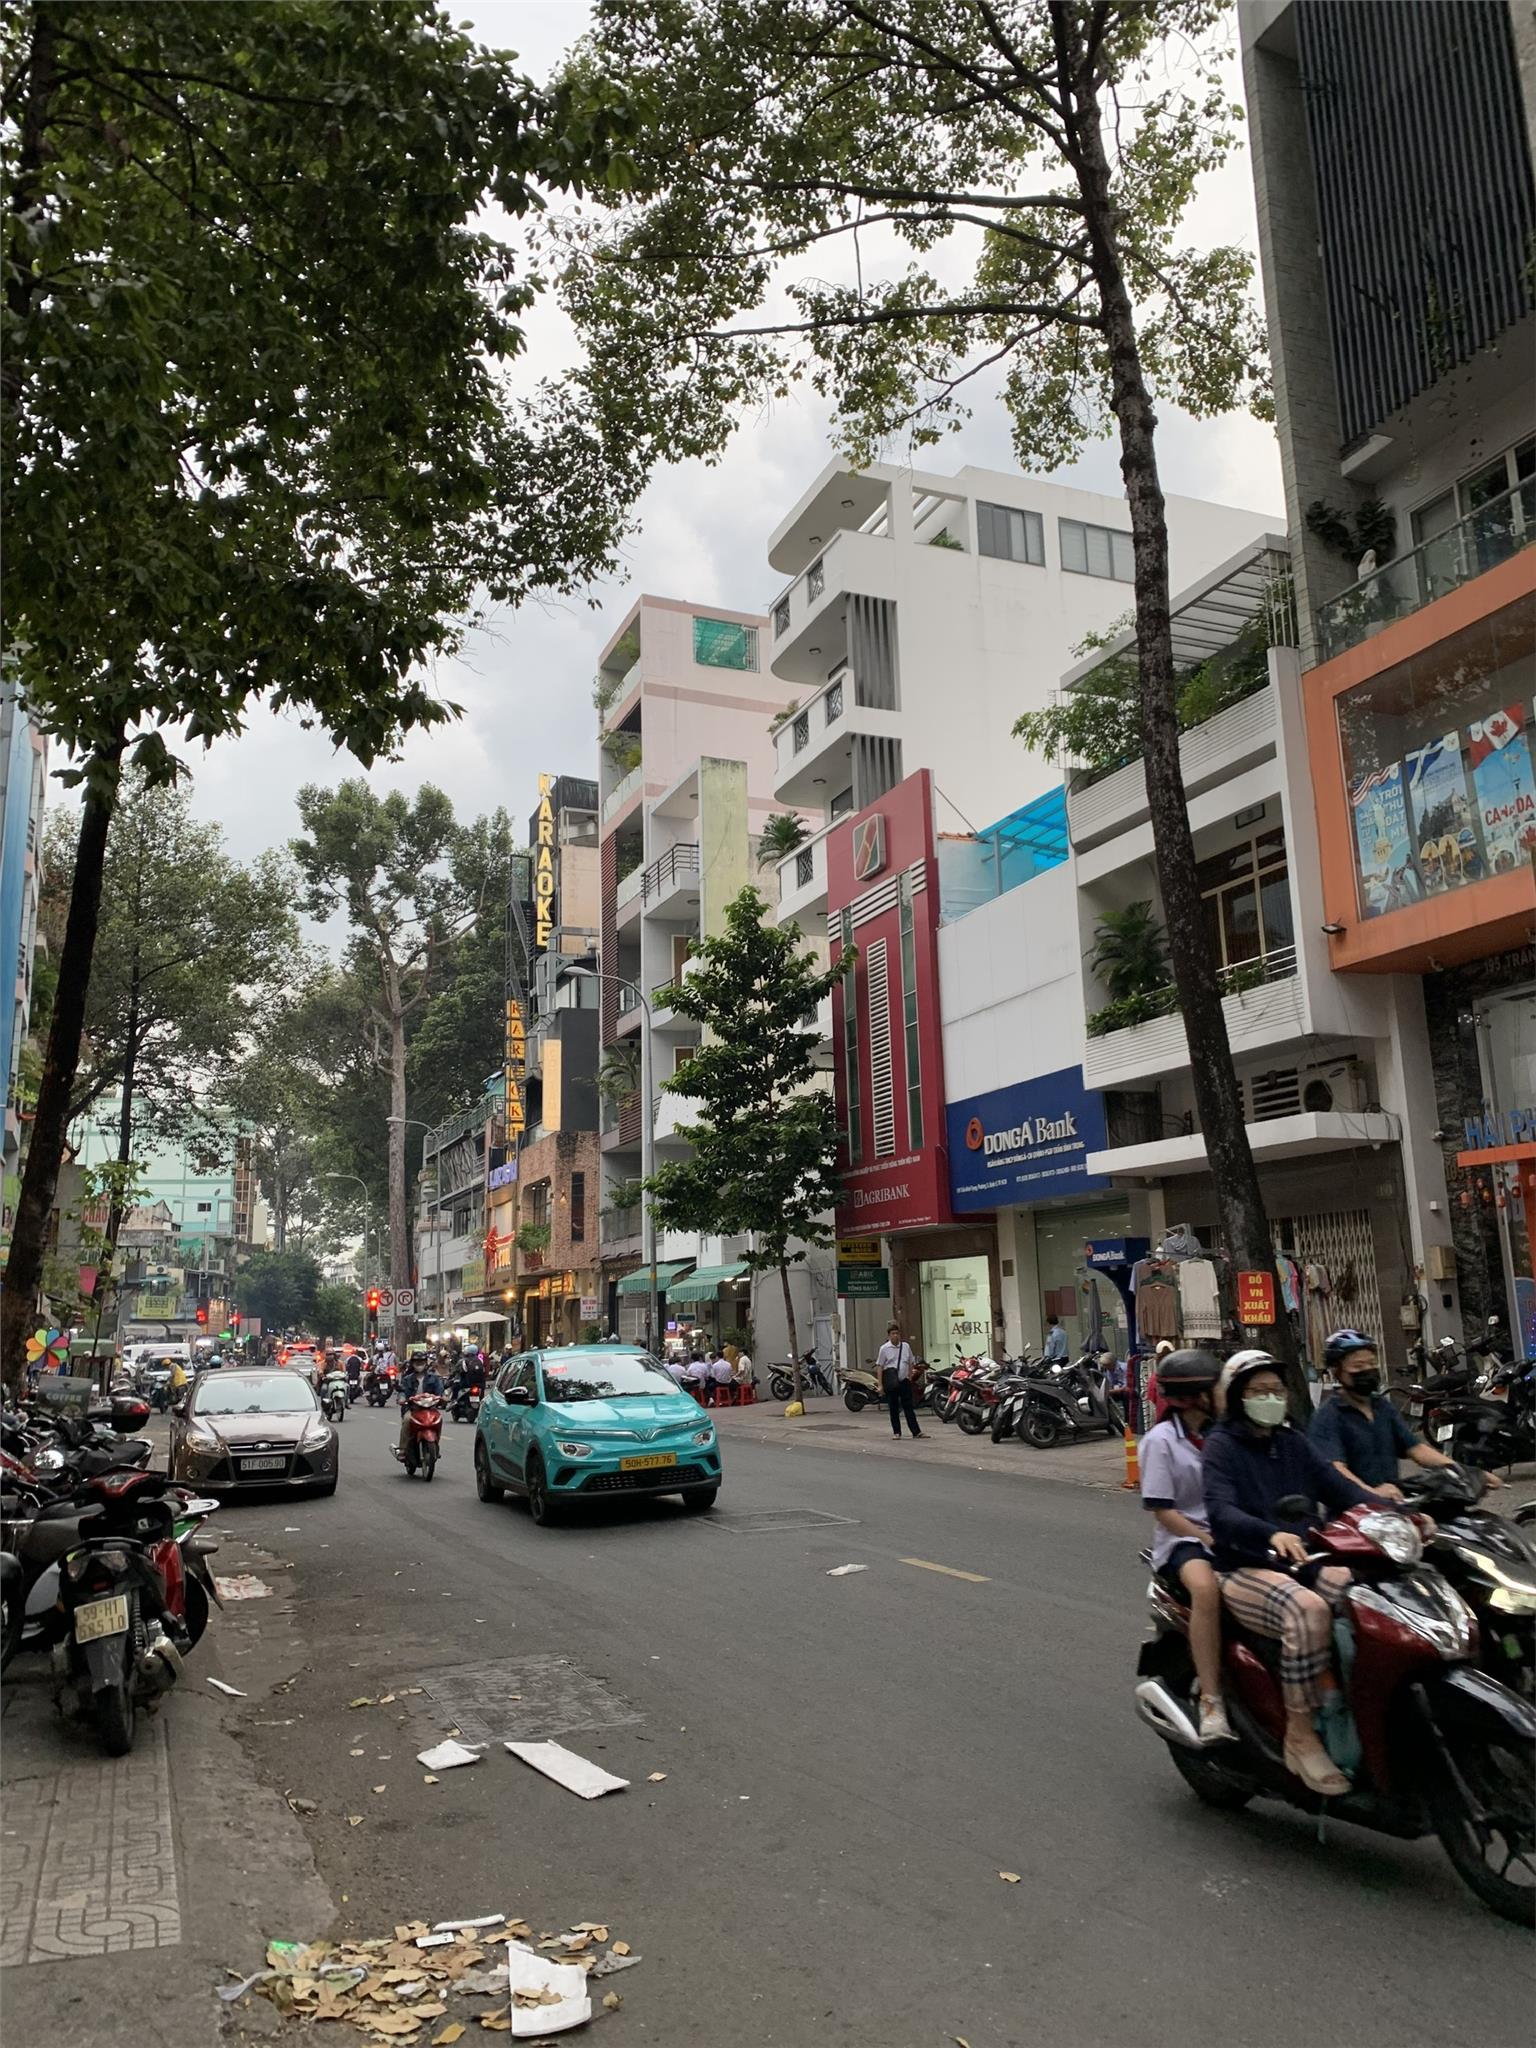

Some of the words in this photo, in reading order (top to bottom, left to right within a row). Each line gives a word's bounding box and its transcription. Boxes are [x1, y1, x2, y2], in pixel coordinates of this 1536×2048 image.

[1485, 794, 1535, 826] CANADA
[537, 772, 553, 947] KARAOKE
[1035, 1110, 1079, 1144] Bank
[863, 1184, 910, 1206] AGRIBANK
[1243, 1299, 1270, 1310] XUẤT
[1249, 1288, 1264, 1297] VN
